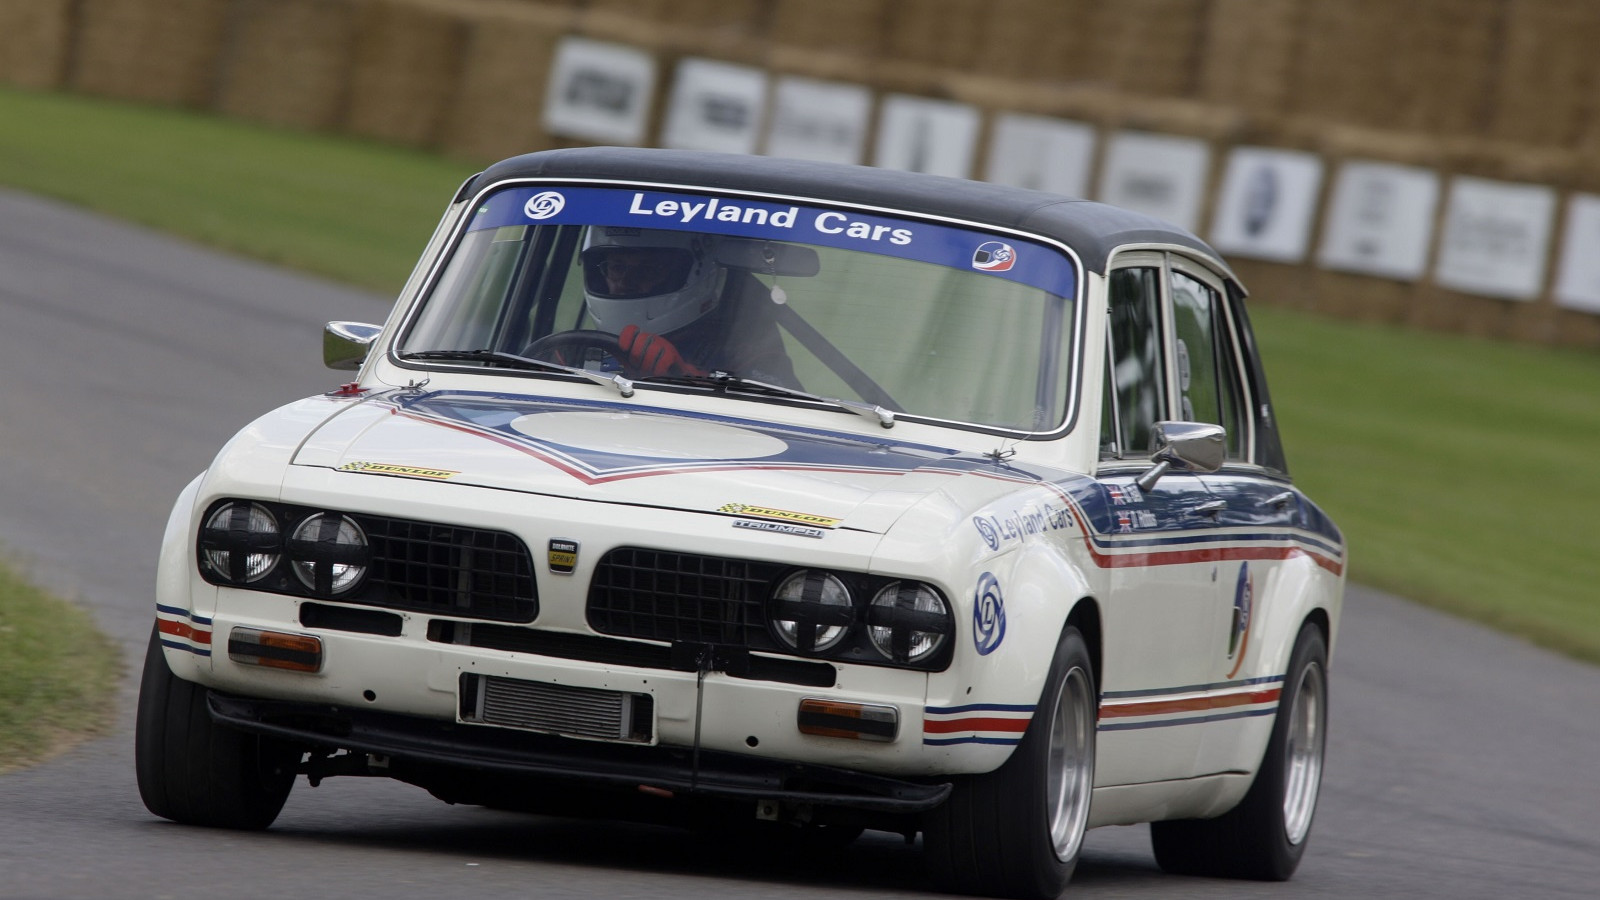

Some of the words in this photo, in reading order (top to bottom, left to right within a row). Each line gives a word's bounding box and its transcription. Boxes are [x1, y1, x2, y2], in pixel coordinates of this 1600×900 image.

[629, 193, 799, 228] Leyland
[814, 212, 912, 245] Cars
[370, 465, 450, 477] DUNLOP
[747, 508, 831, 522] DUNLOP
[735, 520, 822, 537] TRIUMPH
[991, 505, 1046, 543] Leyland
[1045, 503, 1073, 531] Cars
[551, 553, 574, 563] SPRINT
